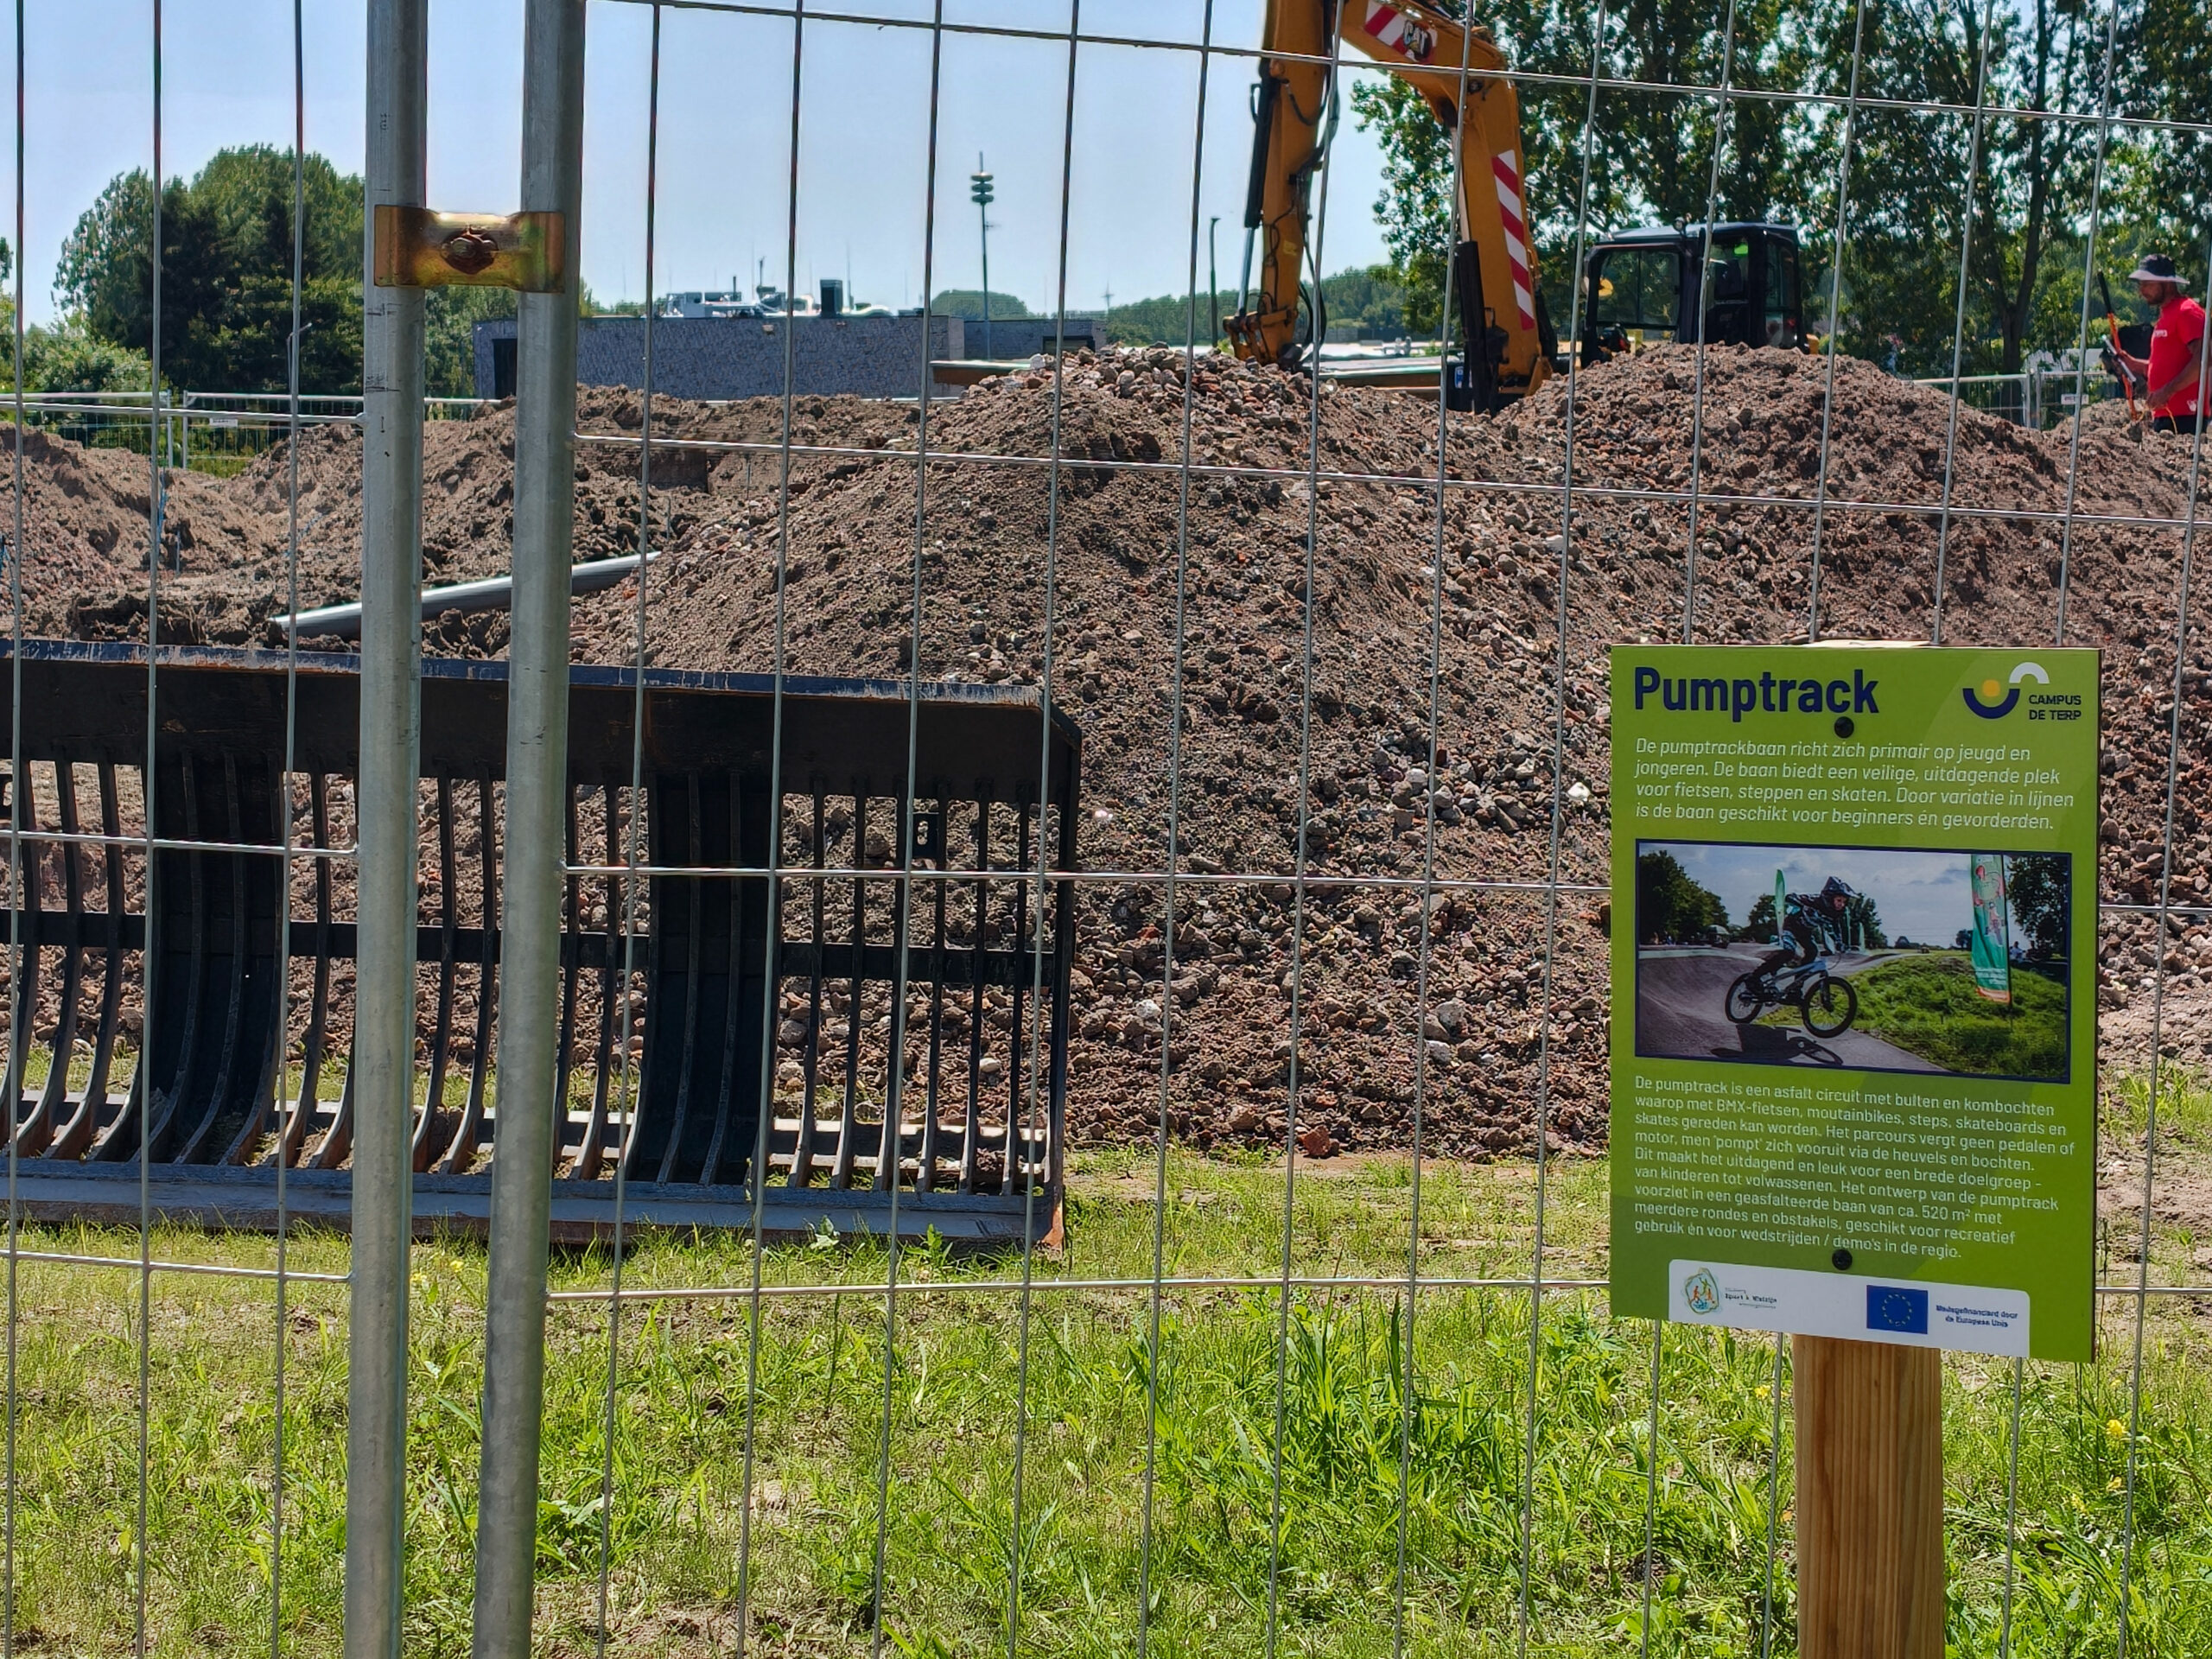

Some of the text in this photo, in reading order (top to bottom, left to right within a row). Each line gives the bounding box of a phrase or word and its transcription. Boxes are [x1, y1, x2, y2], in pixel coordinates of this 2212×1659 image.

[1634, 666, 1879, 722] Pumptrack
[2029, 694, 2082, 706] CAMPUS
[2029, 709, 2082, 721] DE TERP
[1636, 739, 2031, 764] De pumptrackbaan richt zich primair op jeugd en
[1635, 761, 2061, 787] jongeren. De baan biedt een veilige, uitdagende plek
[1636, 783, 2075, 810] voor fietsen, steppen en skaten. Door variatie in lijnen
[1636, 803, 2053, 830] is de baan geschikt voor beginners én gevorderden.
[1636, 1077, 2054, 1115] De pumptrack is een asfalt circuit met bulten en kombochten
[1635, 1097, 1683, 1112] waarop
[1687, 1101, 1713, 1111] met
[1717, 1100, 1802, 1119] BMX-fietsen,
[1909, 1116, 1951, 1130] steps,
[1955, 1117, 2044, 1134] skateboards
[2049, 1126, 2066, 1135] en
[1635, 1113, 2074, 1154] skates gereden kan worden. Het parcours vergt geen pedalen of
[1635, 1134, 1677, 1147] motor,
[1681, 1137, 1710, 1147] men
[1765, 1141, 1793, 1153] zich
[1796, 1145, 1844, 1157] vooruit
[1849, 1147, 1868, 1158] via
[1872, 1147, 1889, 1160] de
[1893, 1149, 1947, 1164] heuvels
[1950, 1155, 1967, 1165] en
[1972, 1154, 2034, 1170] bochten.
[1635, 1148, 1653, 1160] Dit
[1656, 1152, 1697, 1164] maakt
[1701, 1154, 1722, 1166] het
[1726, 1155, 1794, 1173] uitdagend
[1798, 1162, 1814, 1173] en
[1818, 1161, 1847, 1174] leuk
[1850, 1166, 1880, 1177] voor
[1885, 1168, 1910, 1179] een
[1914, 1168, 1955, 1182] brede
[1958, 1172, 2031, 1191] doelgroep
[1635, 1168, 2058, 1209] van kinderen tot volwassenen. Het ontwerp van de pumptrack
[1635, 1185, 1689, 1198] voorziet
[1692, 1187, 1703, 1199] in
[1707, 1192, 1731, 1202] een
[1734, 1193, 1828, 1210] geasfalteerde
[1833, 1199, 1866, 1212] baan
[1870, 1205, 1893, 1215] van
[1897, 1207, 1917, 1217] ca.
[1922, 1206, 1948, 1219] 520
[1974, 1213, 2001, 1224] met
[1635, 1204, 2015, 1243] meerdere rondes en obstakels, geschikt voor recreatief
[1635, 1220, 1684, 1234] gebruik
[1707, 1227, 1737, 1238] voor
[1740, 1230, 1820, 1247] wedstrijden
[1885, 1240, 1896, 1252] in
[1901, 1242, 1917, 1254] de
[1921, 1245, 1961, 1259] regio.
